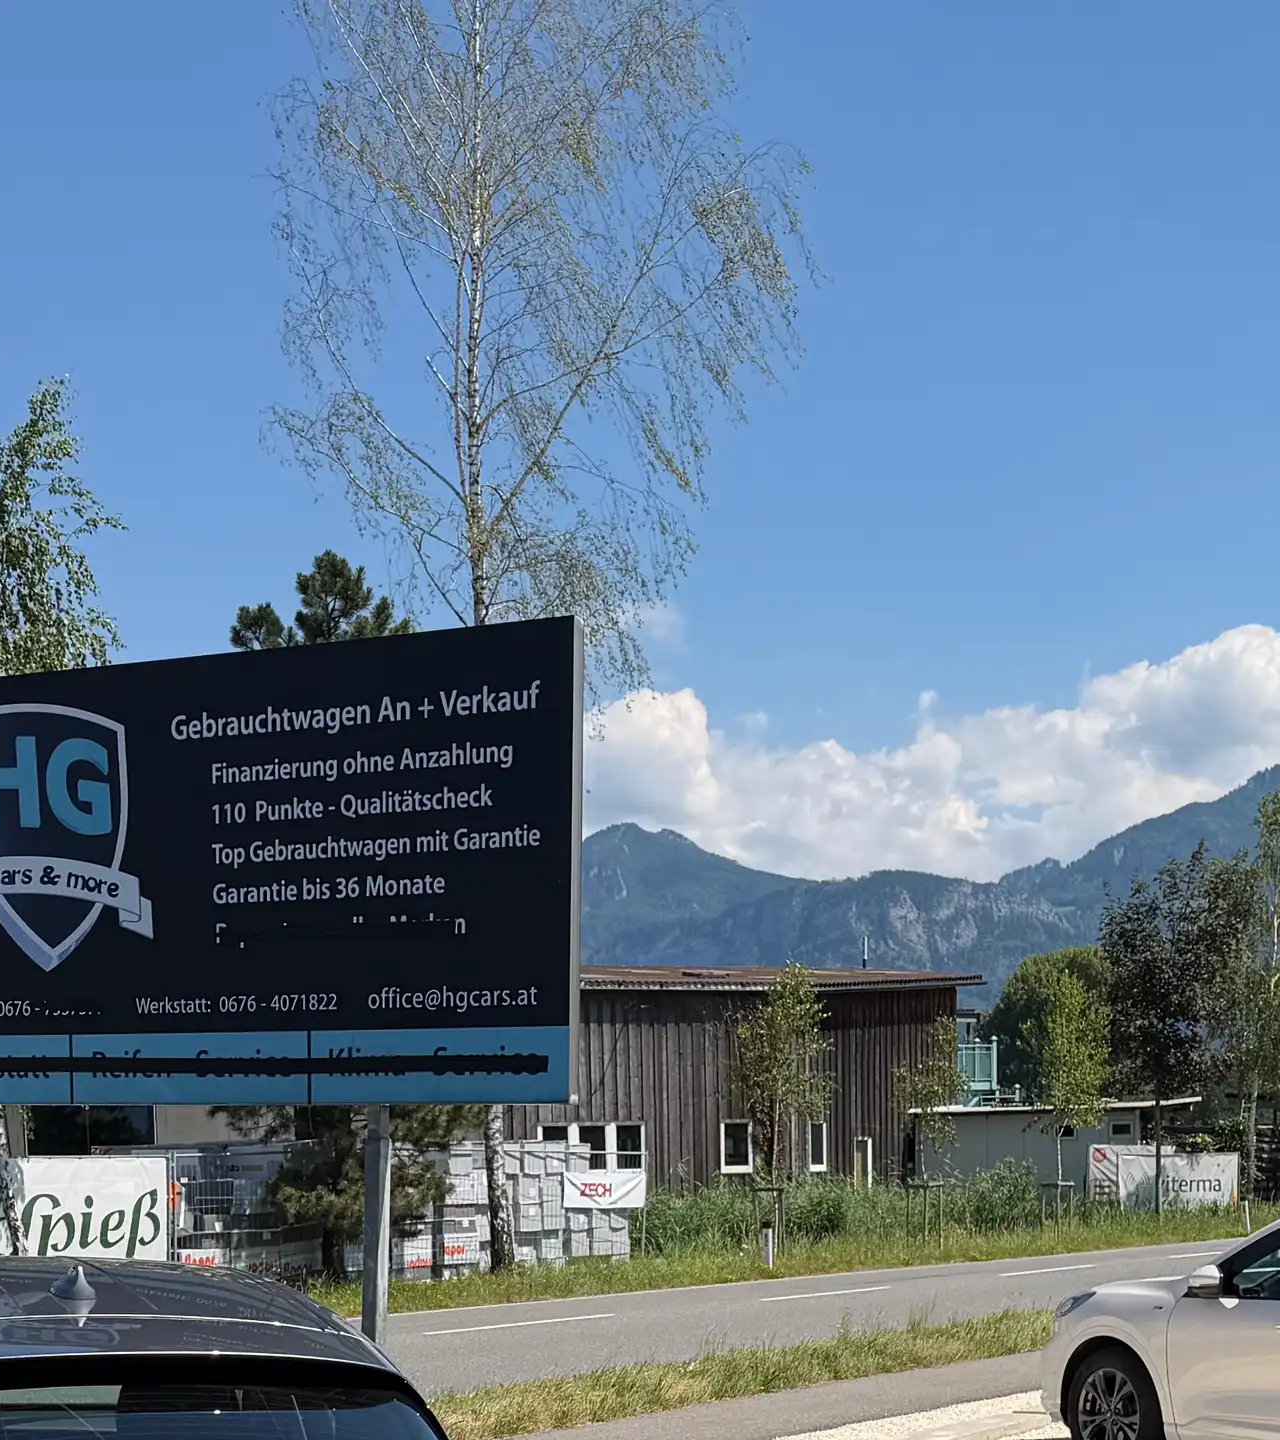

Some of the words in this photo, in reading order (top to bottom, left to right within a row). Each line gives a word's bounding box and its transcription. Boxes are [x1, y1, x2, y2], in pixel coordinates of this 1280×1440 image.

[171, 704, 371, 740] Gebrauchtwagen
[377, 696, 411, 723] An
[417, 698, 435, 719] +
[439, 680, 541, 717] Verkauf
[211, 759, 338, 784] Finanzierung
[343, 751, 395, 775] ohne
[400, 742, 513, 770] Anzahlung
[212, 802, 246, 824] 110
[256, 797, 324, 822] Punkte
[340, 783, 493, 818] Qualitätscheck
[212, 843, 246, 869] Top
[249, 836, 411, 861] Gebrauchtwagen
[416, 829, 449, 853] mit
[454, 824, 541, 851] Garantie
[39, 865, 61, 886] &
[66, 871, 120, 898] more
[212, 880, 298, 904] Garantie
[302, 878, 331, 900] bis
[335, 877, 360, 899] 36
[366, 874, 446, 897] Monate
[135, 997, 212, 1014] Werkstatt:
[218, 995, 257, 1012] 0676
[270, 993, 338, 1012] 4071822
[368, 986, 538, 1012] office@hgcars.at
[580, 1183, 612, 1198] ZECH
